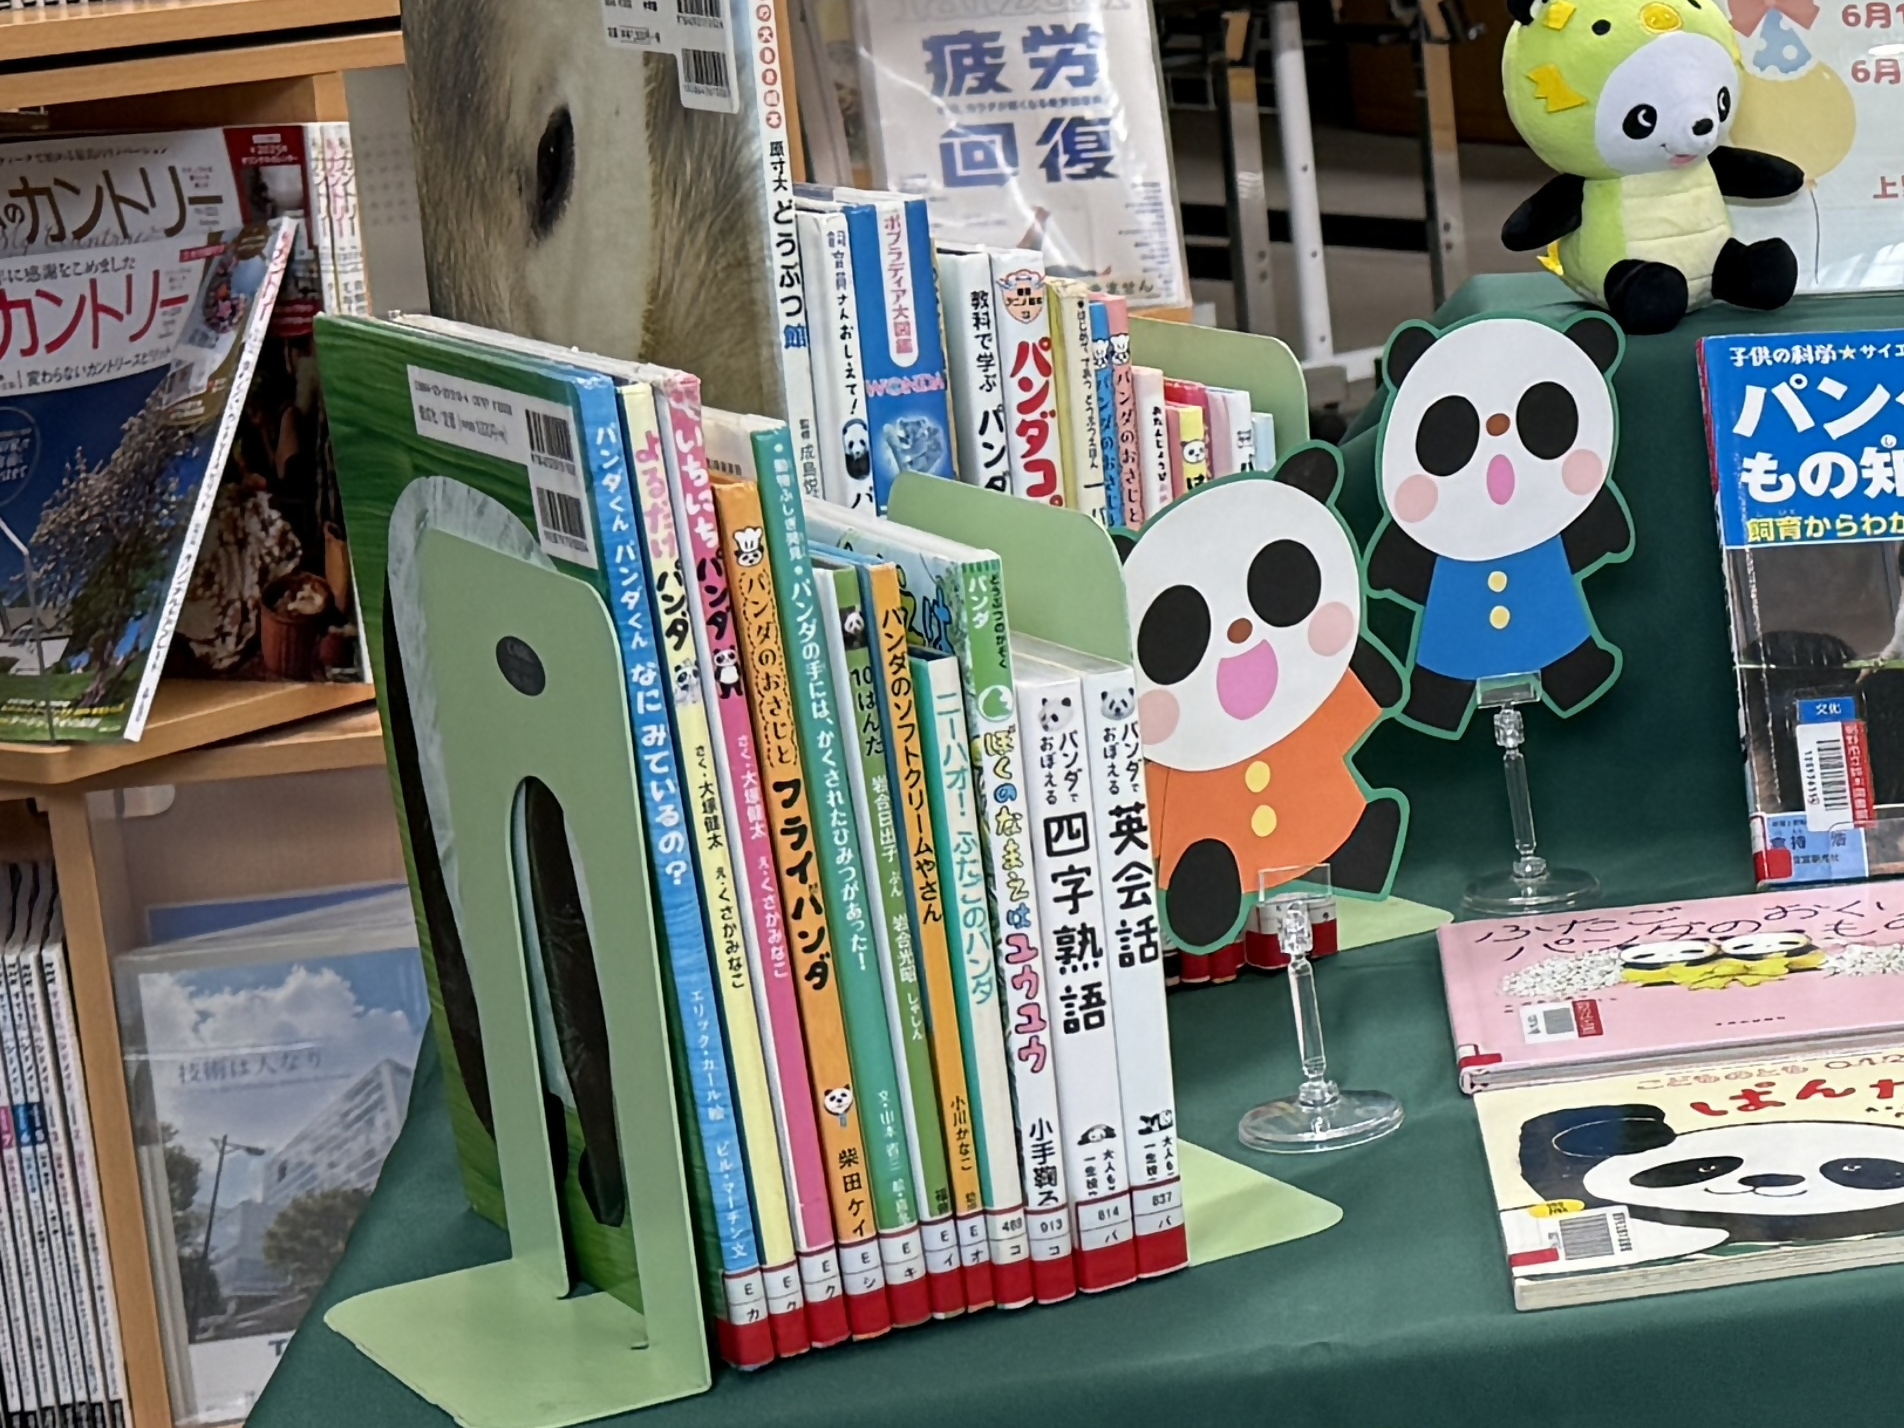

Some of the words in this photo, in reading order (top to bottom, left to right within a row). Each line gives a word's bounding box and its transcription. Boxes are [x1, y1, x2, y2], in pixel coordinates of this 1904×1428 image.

[920, 22, 1103, 99] 疲労
[938, 116, 1118, 190] 回復
[771, 199, 808, 350] どうぶつ館
[968, 290, 999, 393] 教科で学ぶ
[1009, 336, 1065, 508] パンダコ
[595, 425, 630, 533] パンダくん
[635, 429, 678, 559] よるだけ
[675, 426, 717, 550] いちにち
[696, 548, 731, 641] パンダ
[615, 543, 650, 650] パンダくん
[656, 558, 690, 651] パンダ
[968, 575, 990, 630] パンダ
[630, 660, 664, 715] なに
[1815, 704, 1842, 715] 文化
[640, 723, 689, 886] みているの？
[746, 571, 794, 765] パンダのおさじと
[772, 778, 833, 990] フライパンダ
[789, 580, 868, 971] パンダの手には、かくされたひみつがあった！
[882, 608, 943, 925] パンダのソフトクリームやさん
[936, 692, 970, 818] ニーハオ！
[1040, 735, 1058, 805] おぼえる
[1102, 726, 1120, 796] おぼえる
[983, 723, 1033, 930] ぼくのなまえは
[952, 830, 993, 1005] ふたごのパンダ
[1042, 811, 1107, 1035] 四字熟語
[1108, 801, 1159, 969] 英会話
[1004, 932, 1048, 1074] ユウユウ
[1636, 1065, 1809, 1091] こどものとも
[950, 1095, 974, 1171] 小川かなこ
[838, 1147, 866, 1238] 柴田ケイ
[1097, 1205, 1120, 1221] 814
[1152, 1190, 1173, 1206] 837
